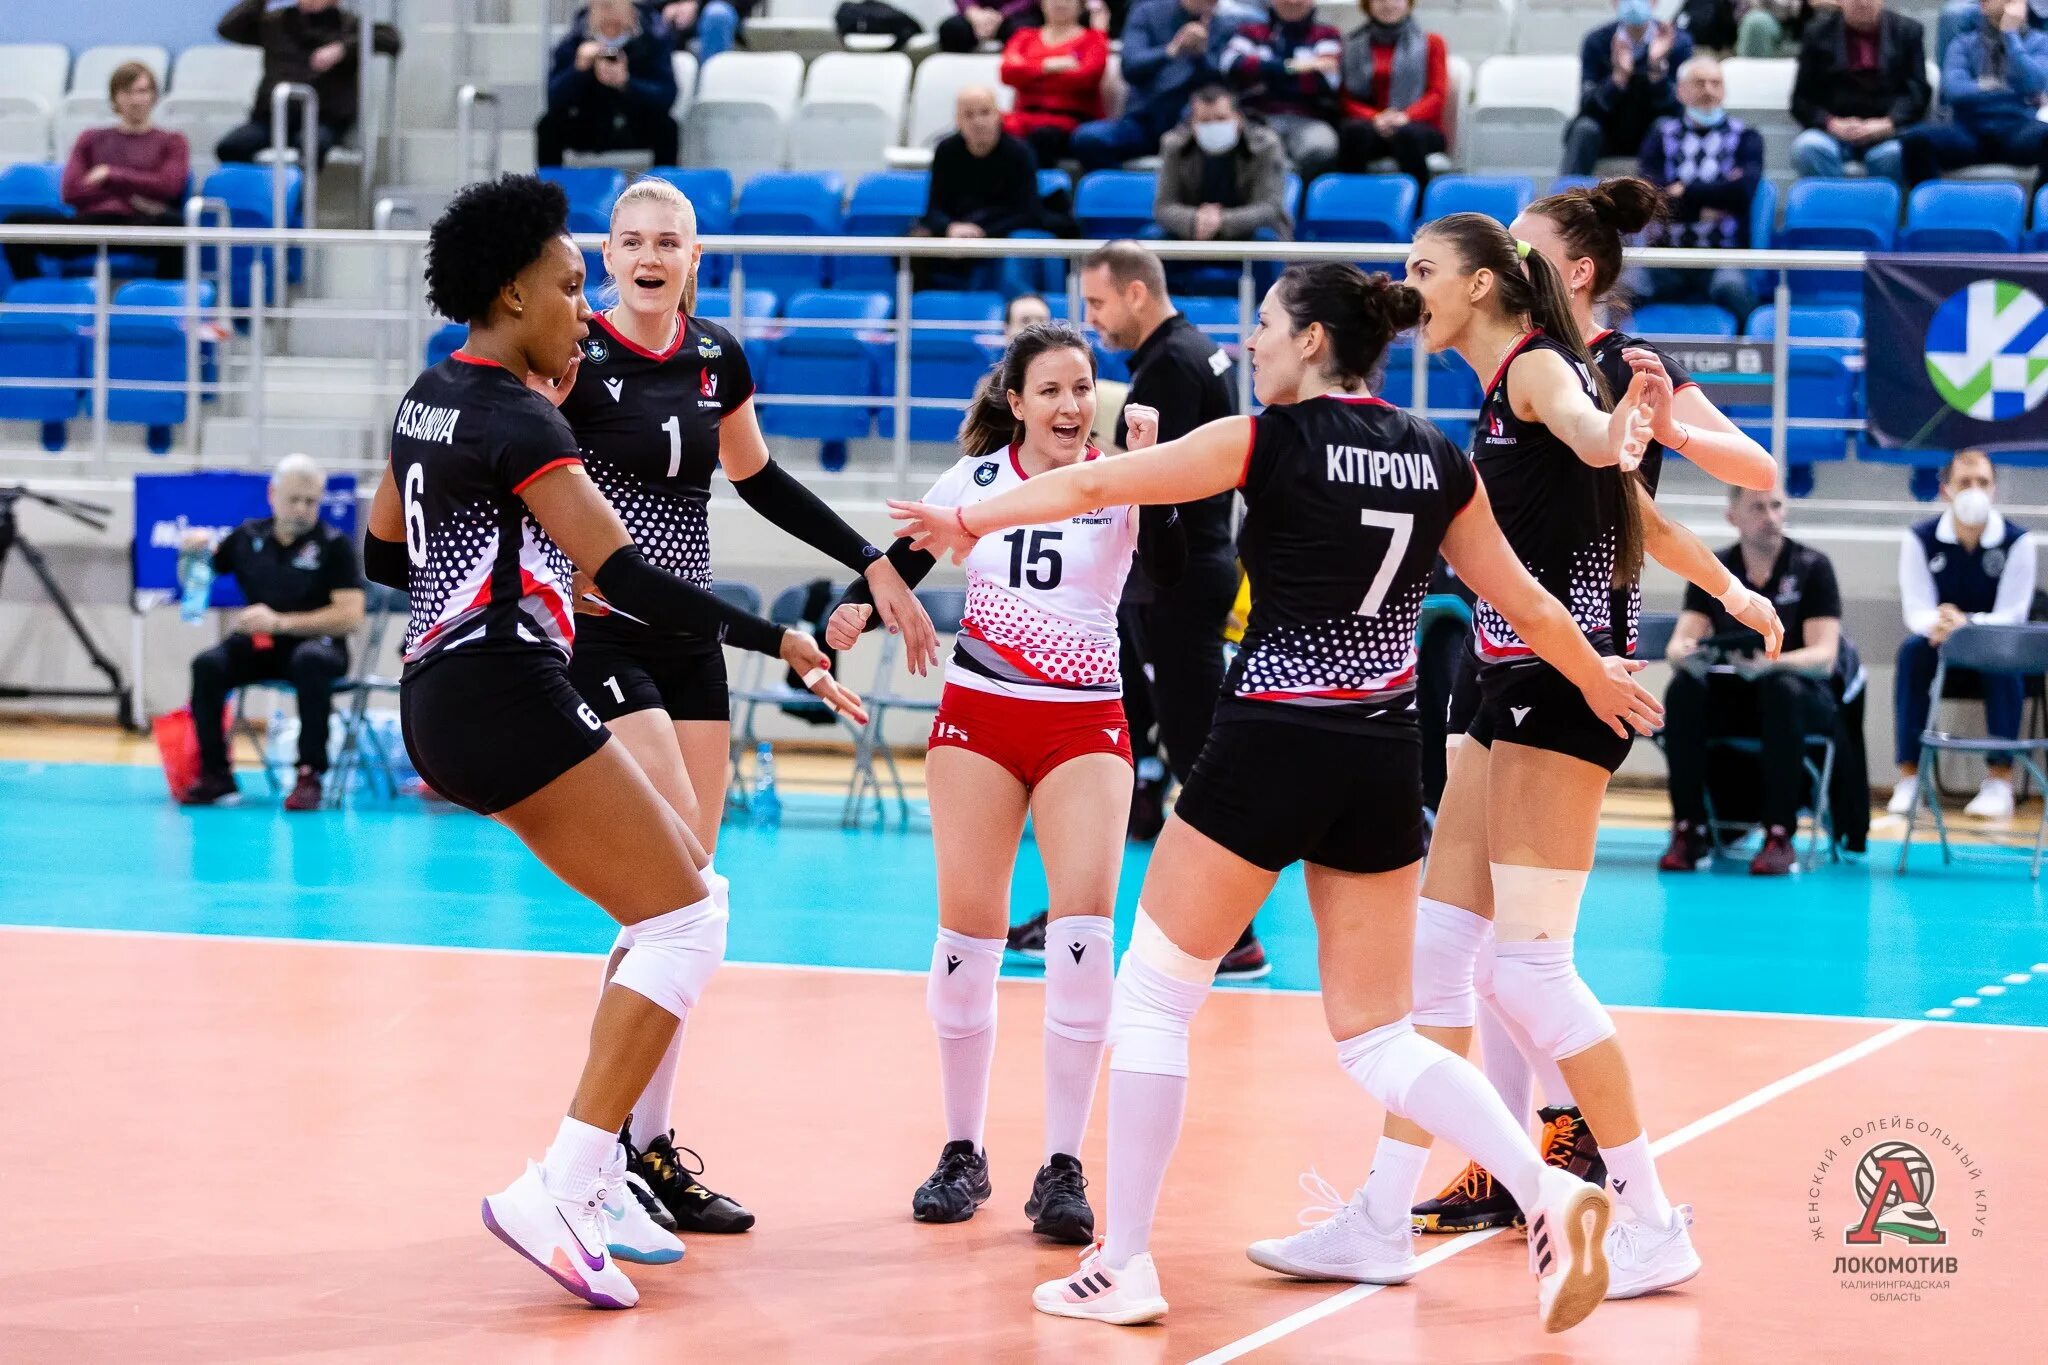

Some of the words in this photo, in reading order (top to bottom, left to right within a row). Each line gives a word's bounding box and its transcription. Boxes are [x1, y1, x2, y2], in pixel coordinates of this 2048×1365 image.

[661, 416, 682, 477] 1
[1326, 444, 1439, 490] KITIPOVA
[405, 462, 427, 568] 6
[1081, 517, 1112, 525] PROMETEY
[1003, 529, 1064, 590] 15
[1357, 508, 1414, 617] 7
[602, 675, 626, 704] 1
[577, 702, 602, 731] 6
